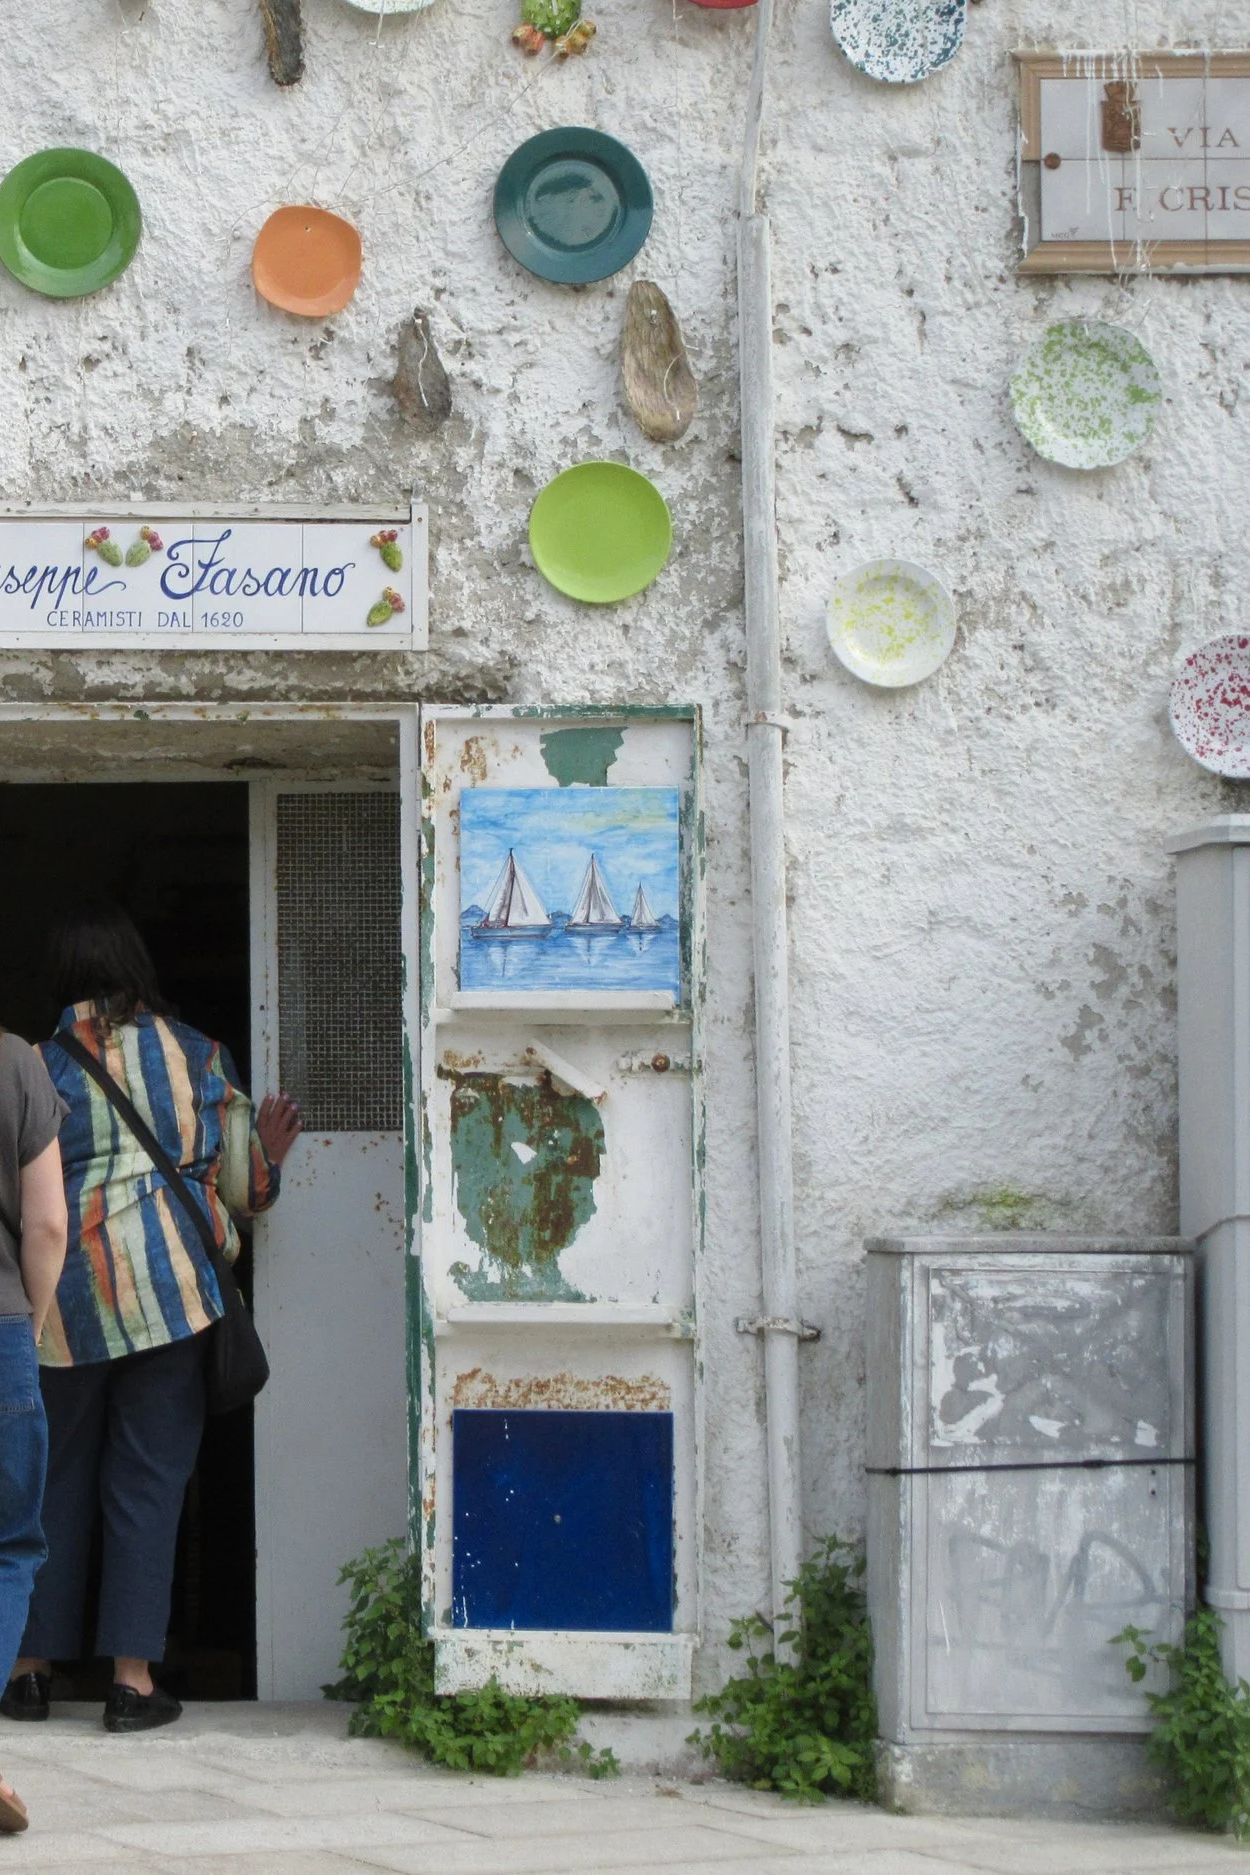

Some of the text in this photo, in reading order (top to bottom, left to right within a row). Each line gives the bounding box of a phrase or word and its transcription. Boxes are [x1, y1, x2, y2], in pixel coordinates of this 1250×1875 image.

[1167, 126, 1241, 148] VIA
[160, 528, 356, 600] Fasano
[46, 610, 244, 629] CERAMISTI DAL 1620
